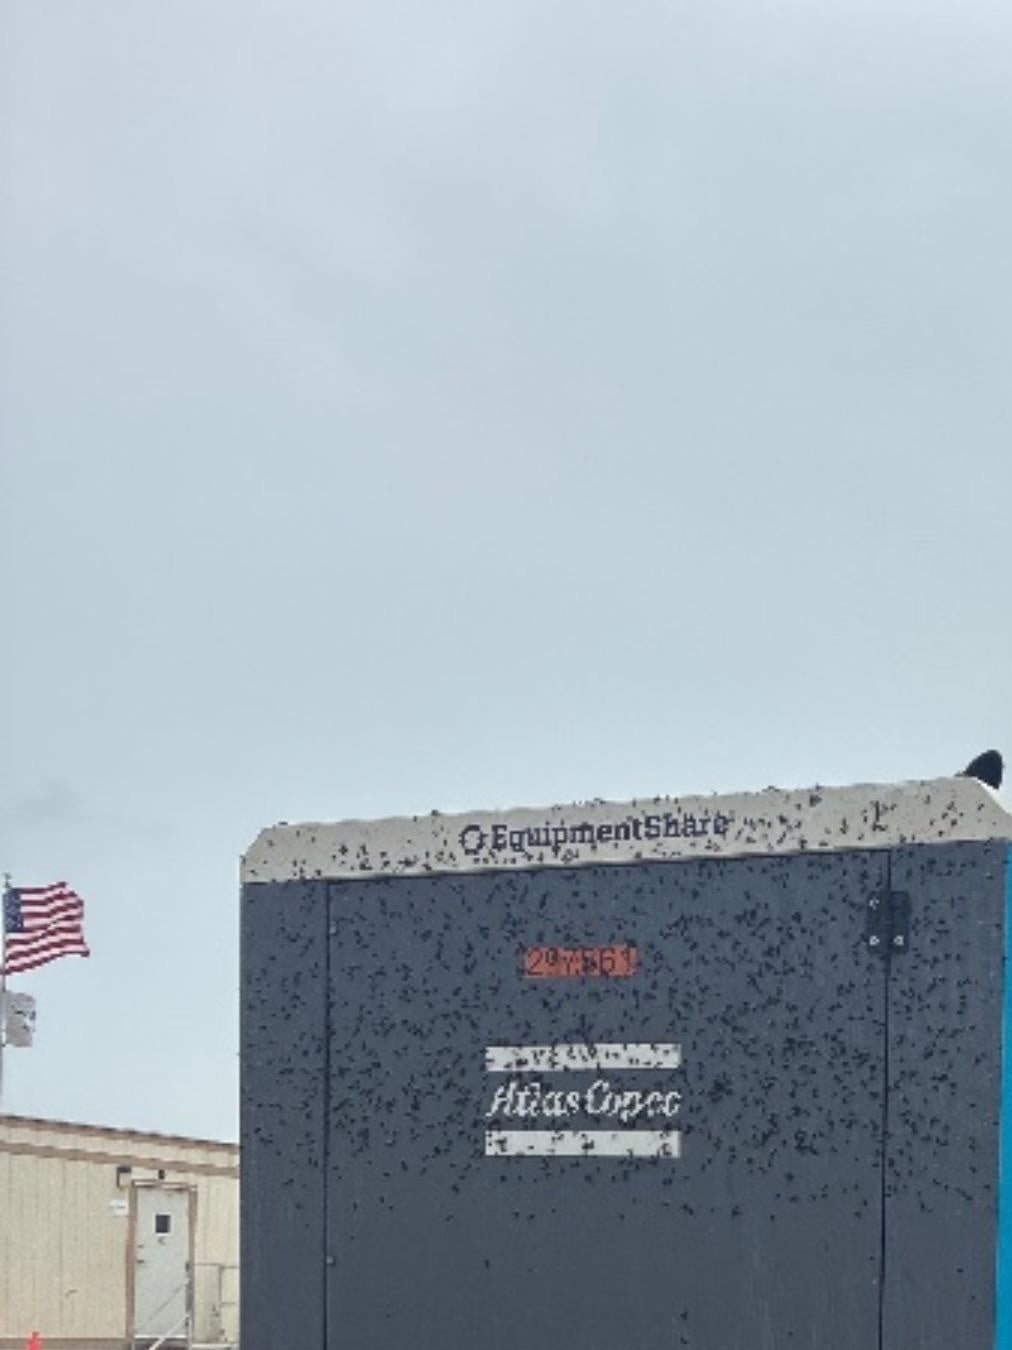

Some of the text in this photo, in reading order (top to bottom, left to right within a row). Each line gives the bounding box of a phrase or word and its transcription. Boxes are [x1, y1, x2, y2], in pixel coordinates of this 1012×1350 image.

[490, 814, 729, 852] EquipmentShare
[485, 1079, 682, 1122] Atlas Copco
